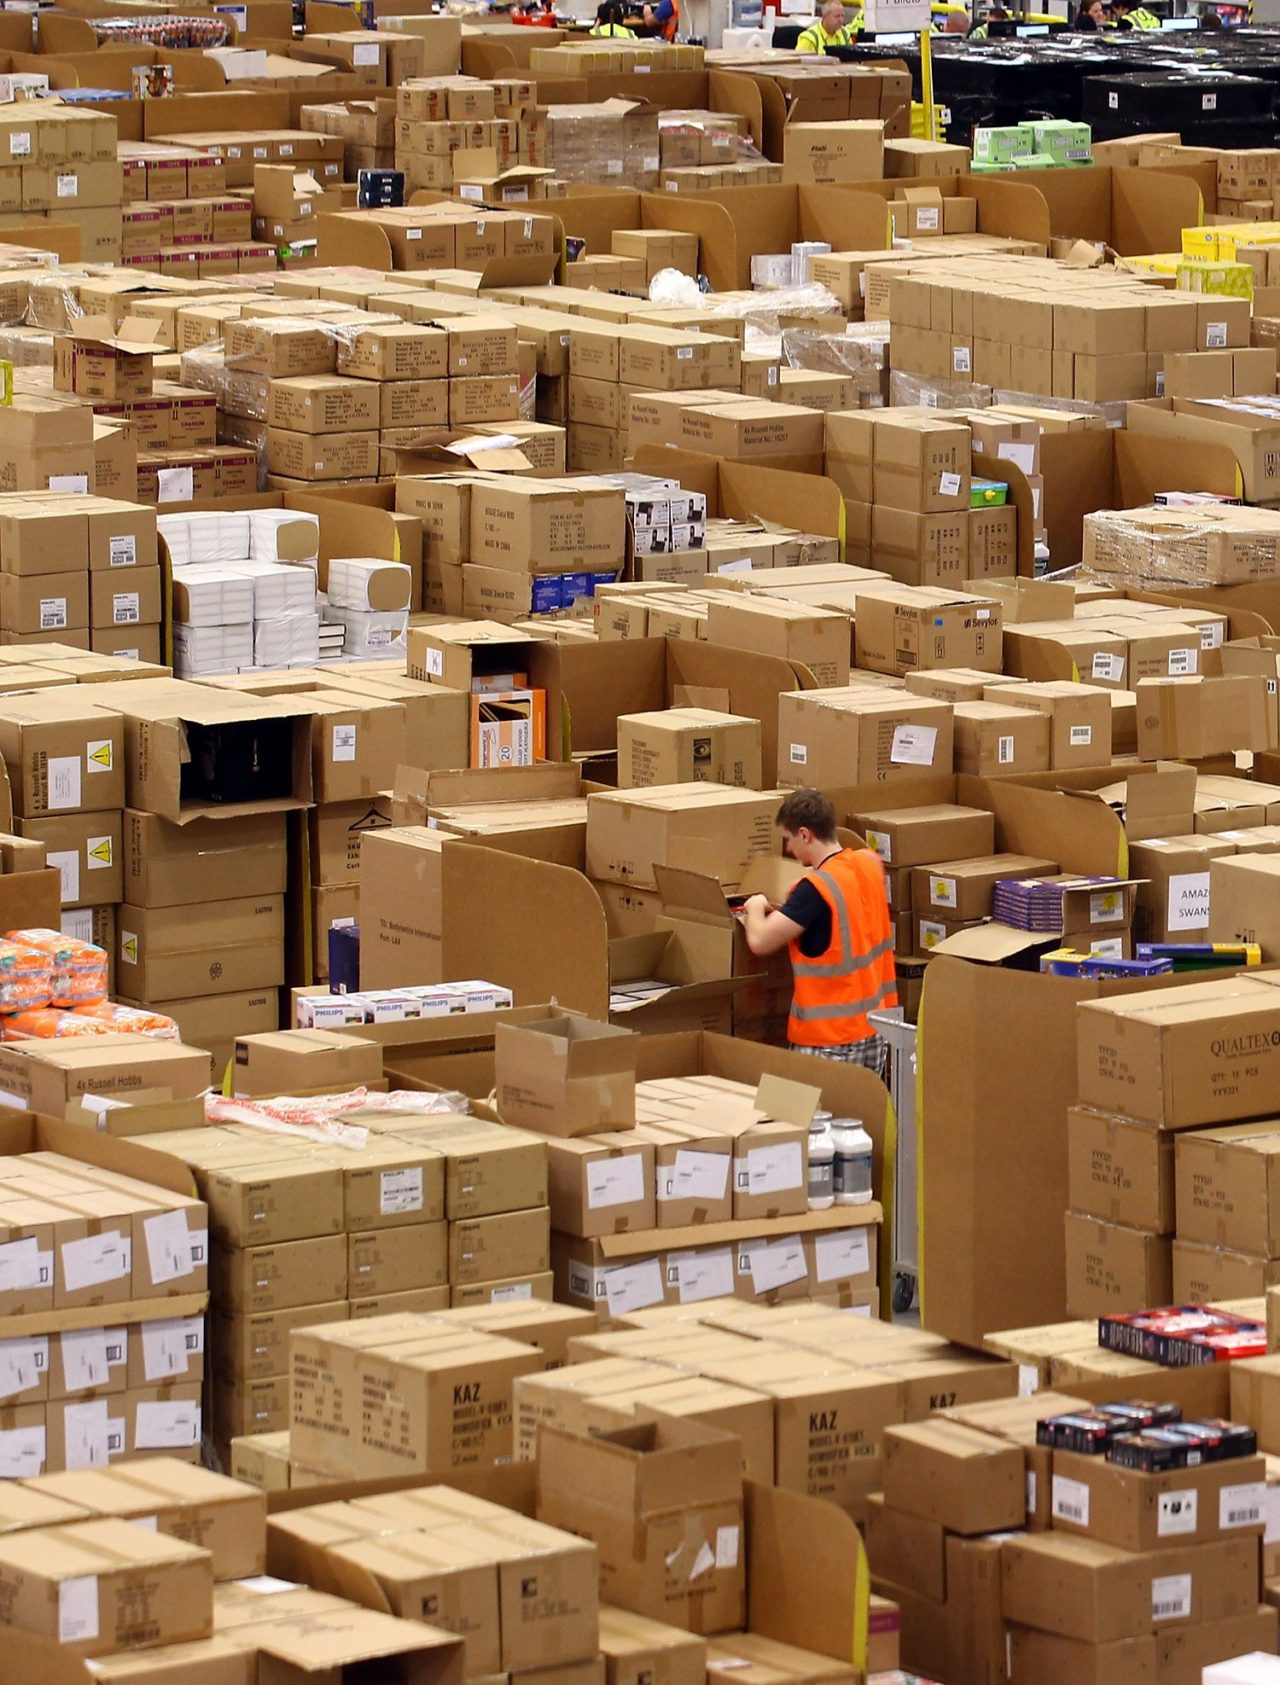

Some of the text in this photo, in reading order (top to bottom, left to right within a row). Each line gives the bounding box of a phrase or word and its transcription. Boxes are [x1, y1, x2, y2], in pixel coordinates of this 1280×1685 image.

[900, 607, 917, 619] Sevylor
[973, 617, 998, 628] Sevylor
[501, 746, 510, 760] 20
[1181, 888, 1209, 899] AMAZ
[422, 1000, 449, 1008] PHILIPS
[467, 994, 494, 1003] PHILIPS
[315, 1009, 344, 1017] PHILIPS
[376, 1003, 403, 1012] PHILIPS
[1210, 1033, 1271, 1057] QUALTEX
[1245, 1067, 1259, 1076] PCS
[88, 1076, 116, 1088] Russell
[118, 1075, 142, 1086] Hobbs
[453, 1383, 481, 1405] KAZ
[930, 1393, 957, 1410] KAZ
[809, 1410, 838, 1433] KAZ
